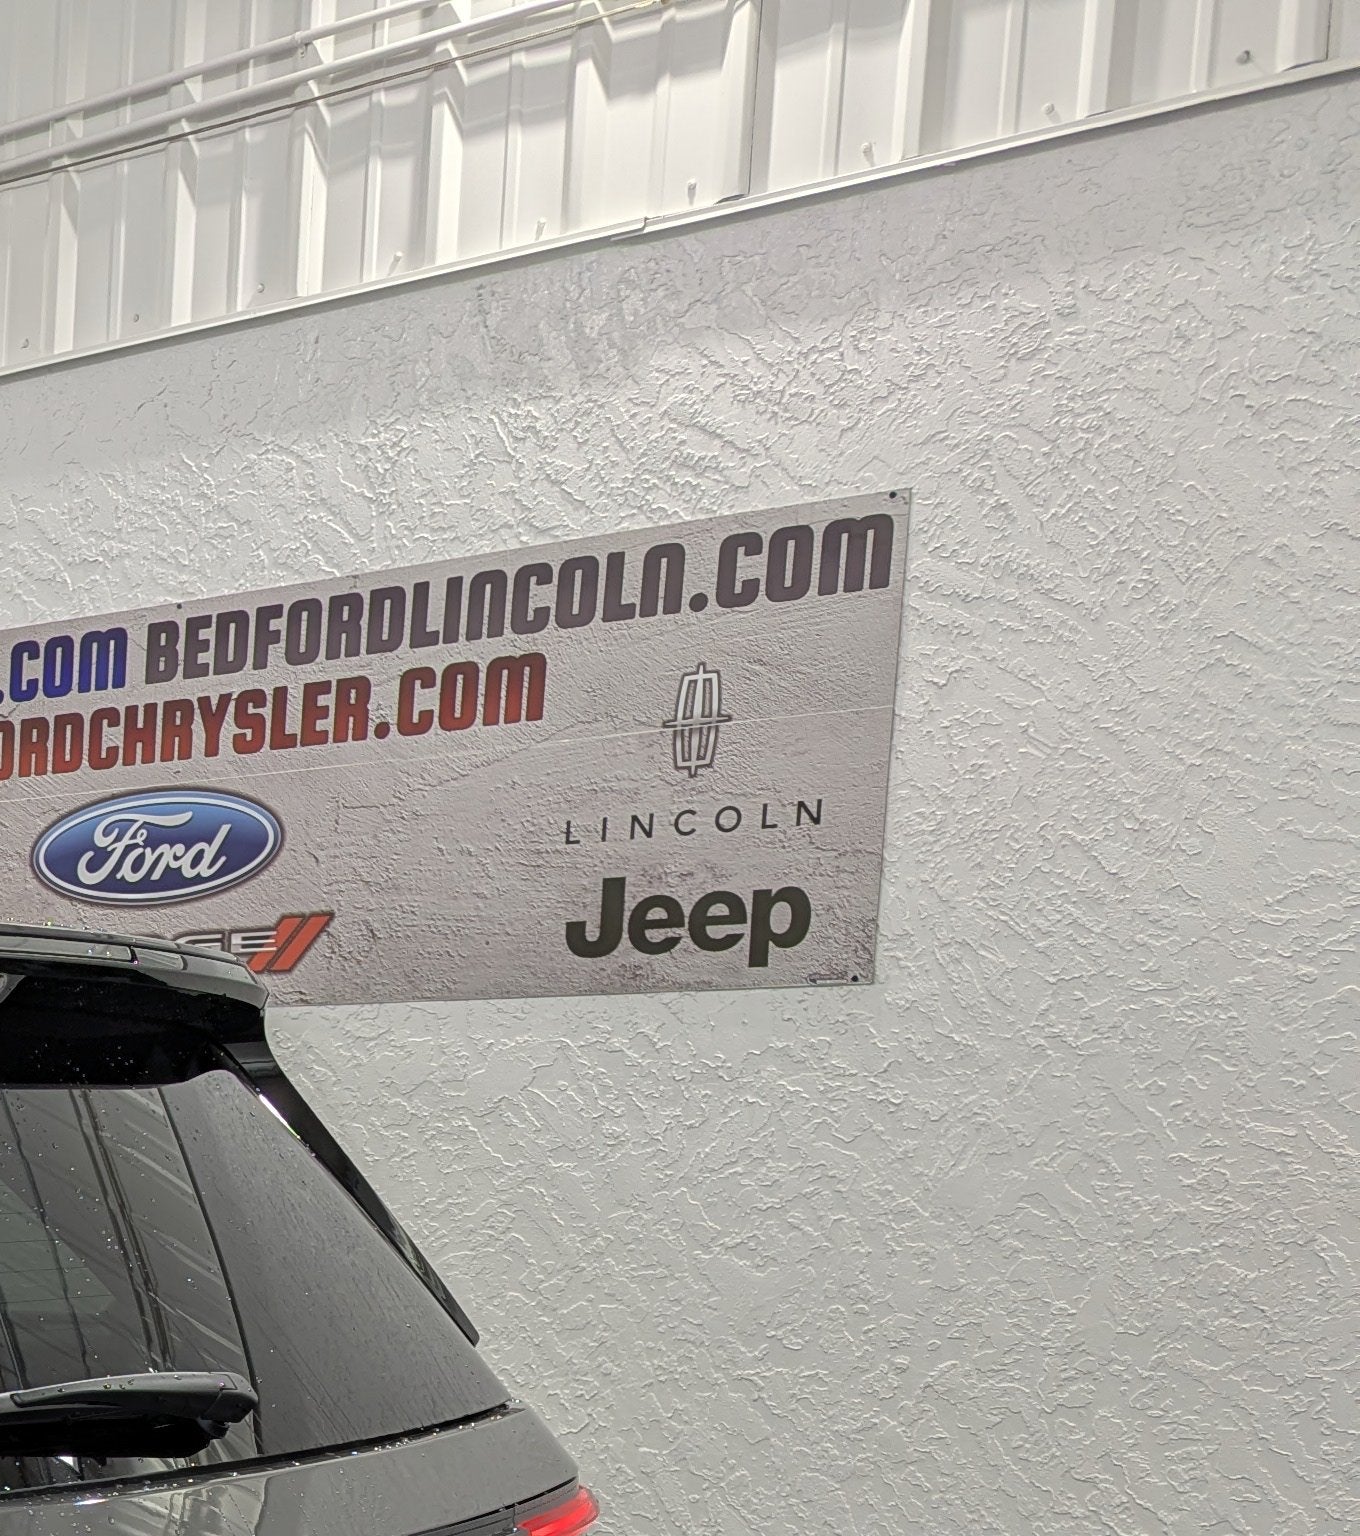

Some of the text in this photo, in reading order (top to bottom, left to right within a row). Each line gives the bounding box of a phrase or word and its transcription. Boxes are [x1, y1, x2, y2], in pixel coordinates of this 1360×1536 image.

[145, 513, 894, 684] BEDFORDLINCOLN.COM
[77, 810, 232, 883] Ford
[565, 798, 824, 845] LINCOLN
[565, 876, 813, 968] Jeep
